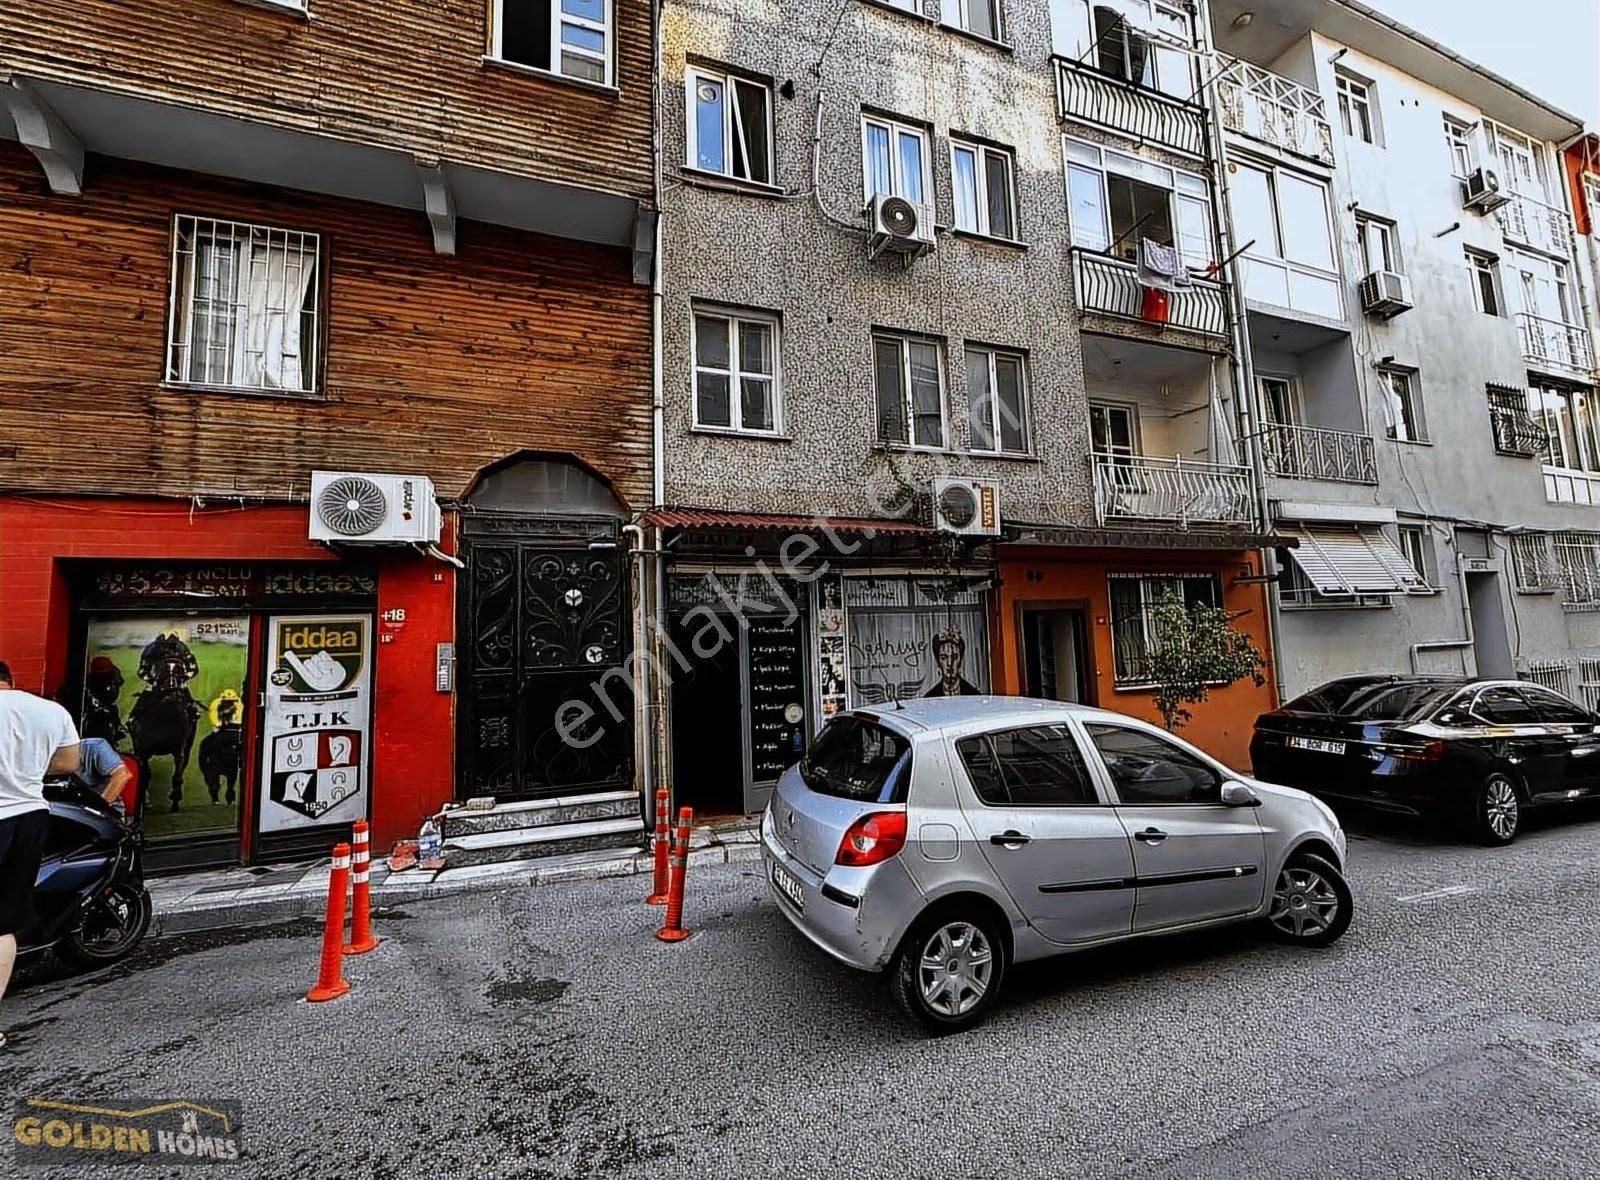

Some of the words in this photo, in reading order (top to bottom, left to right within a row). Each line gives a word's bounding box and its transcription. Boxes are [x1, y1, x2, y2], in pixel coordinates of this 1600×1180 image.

[982, 489, 993, 526] VESTEL
[381, 608, 405, 621] +18
[197, 623, 219, 634] 521
[284, 627, 357, 649] iddaa
[286, 711, 350, 729] T.J.K
[305, 801, 328, 812] 1950
